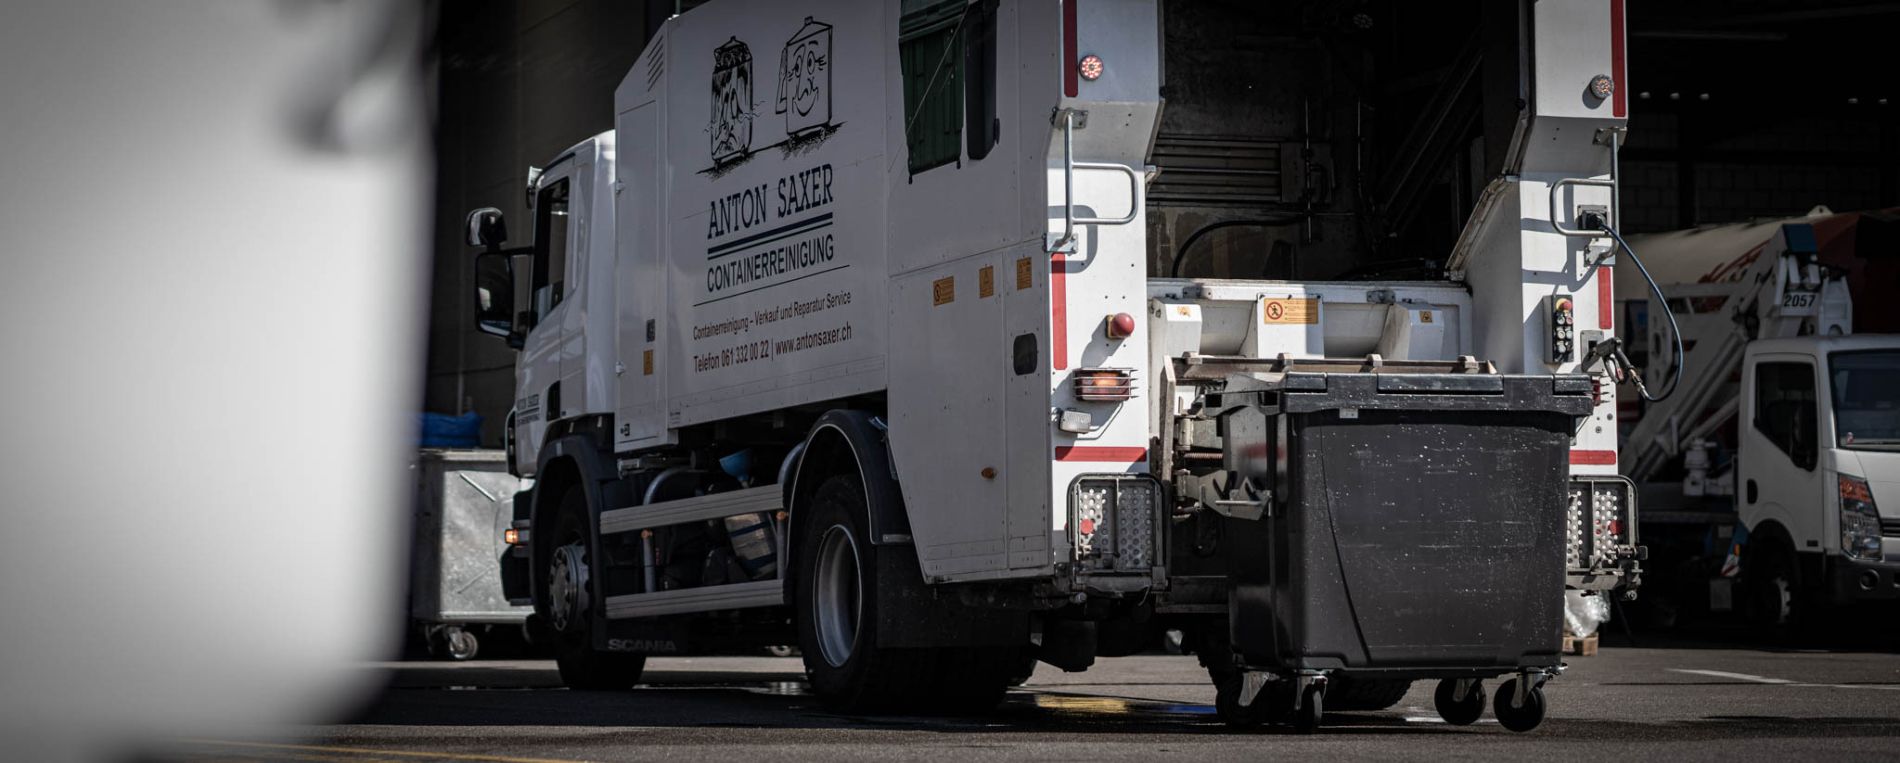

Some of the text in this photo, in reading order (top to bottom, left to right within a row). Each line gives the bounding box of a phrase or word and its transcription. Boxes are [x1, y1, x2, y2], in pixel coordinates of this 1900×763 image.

[707, 163, 834, 240] ANTON SAXER
[707, 234, 835, 293] CONTAINERREINIGUNG
[693, 317, 749, 341] Containerreinigung
[755, 305, 780, 326] Verkauf
[780, 301, 794, 320] und
[794, 297, 826, 319] Reparatur
[826, 290, 852, 309] Service
[1783, 294, 1817, 307] 2057
[693, 352, 720, 373] Telefon
[721, 347, 734, 368] 061
[735, 343, 749, 364] 332
[749, 342, 759, 361] 00
[760, 339, 770, 359] 22
[775, 320, 852, 356] www.antonsaxer.ch
[607, 638, 677, 653] SCANIA
